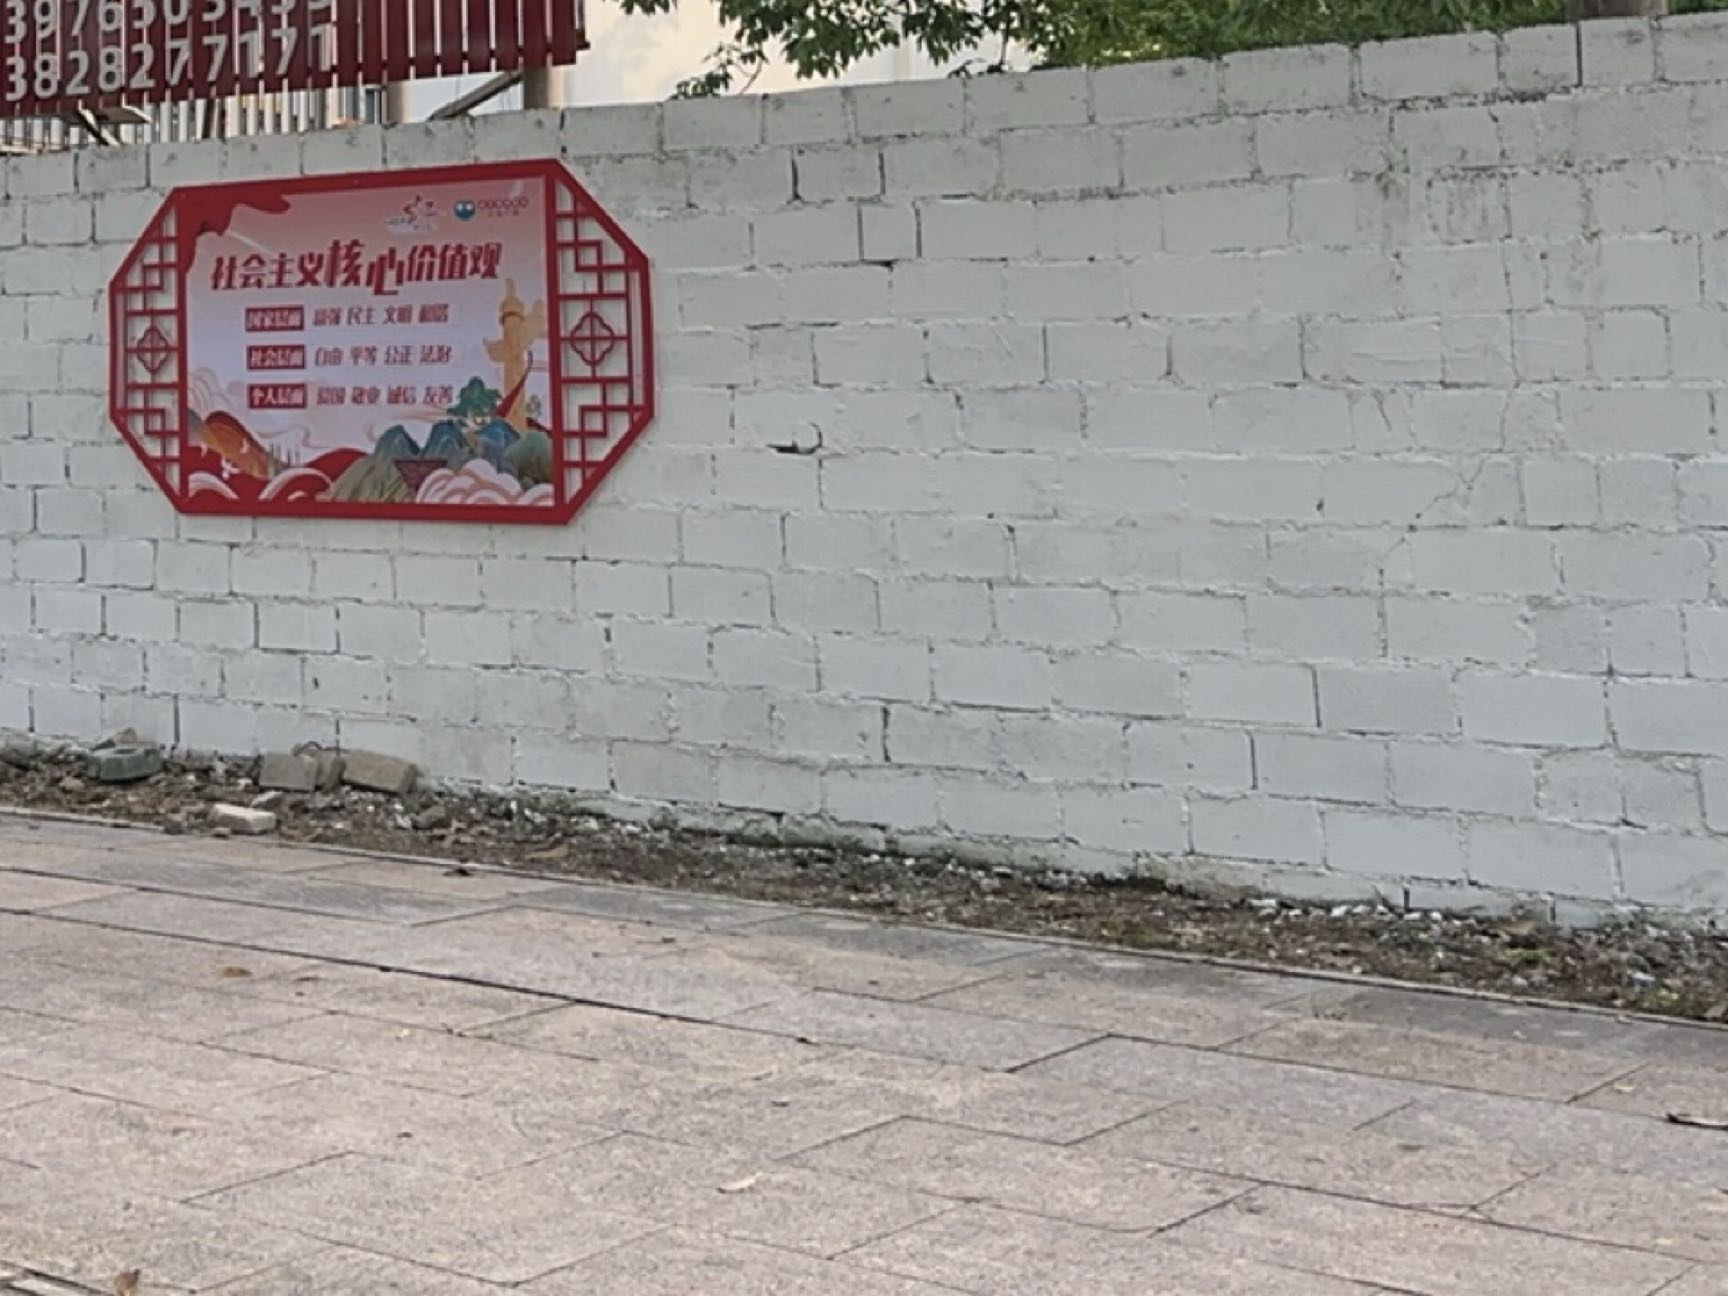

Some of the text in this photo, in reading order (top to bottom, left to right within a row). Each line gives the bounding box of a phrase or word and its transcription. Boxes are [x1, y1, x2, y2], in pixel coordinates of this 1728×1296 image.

[211, 239, 503, 296] 社会主义核心价值观
